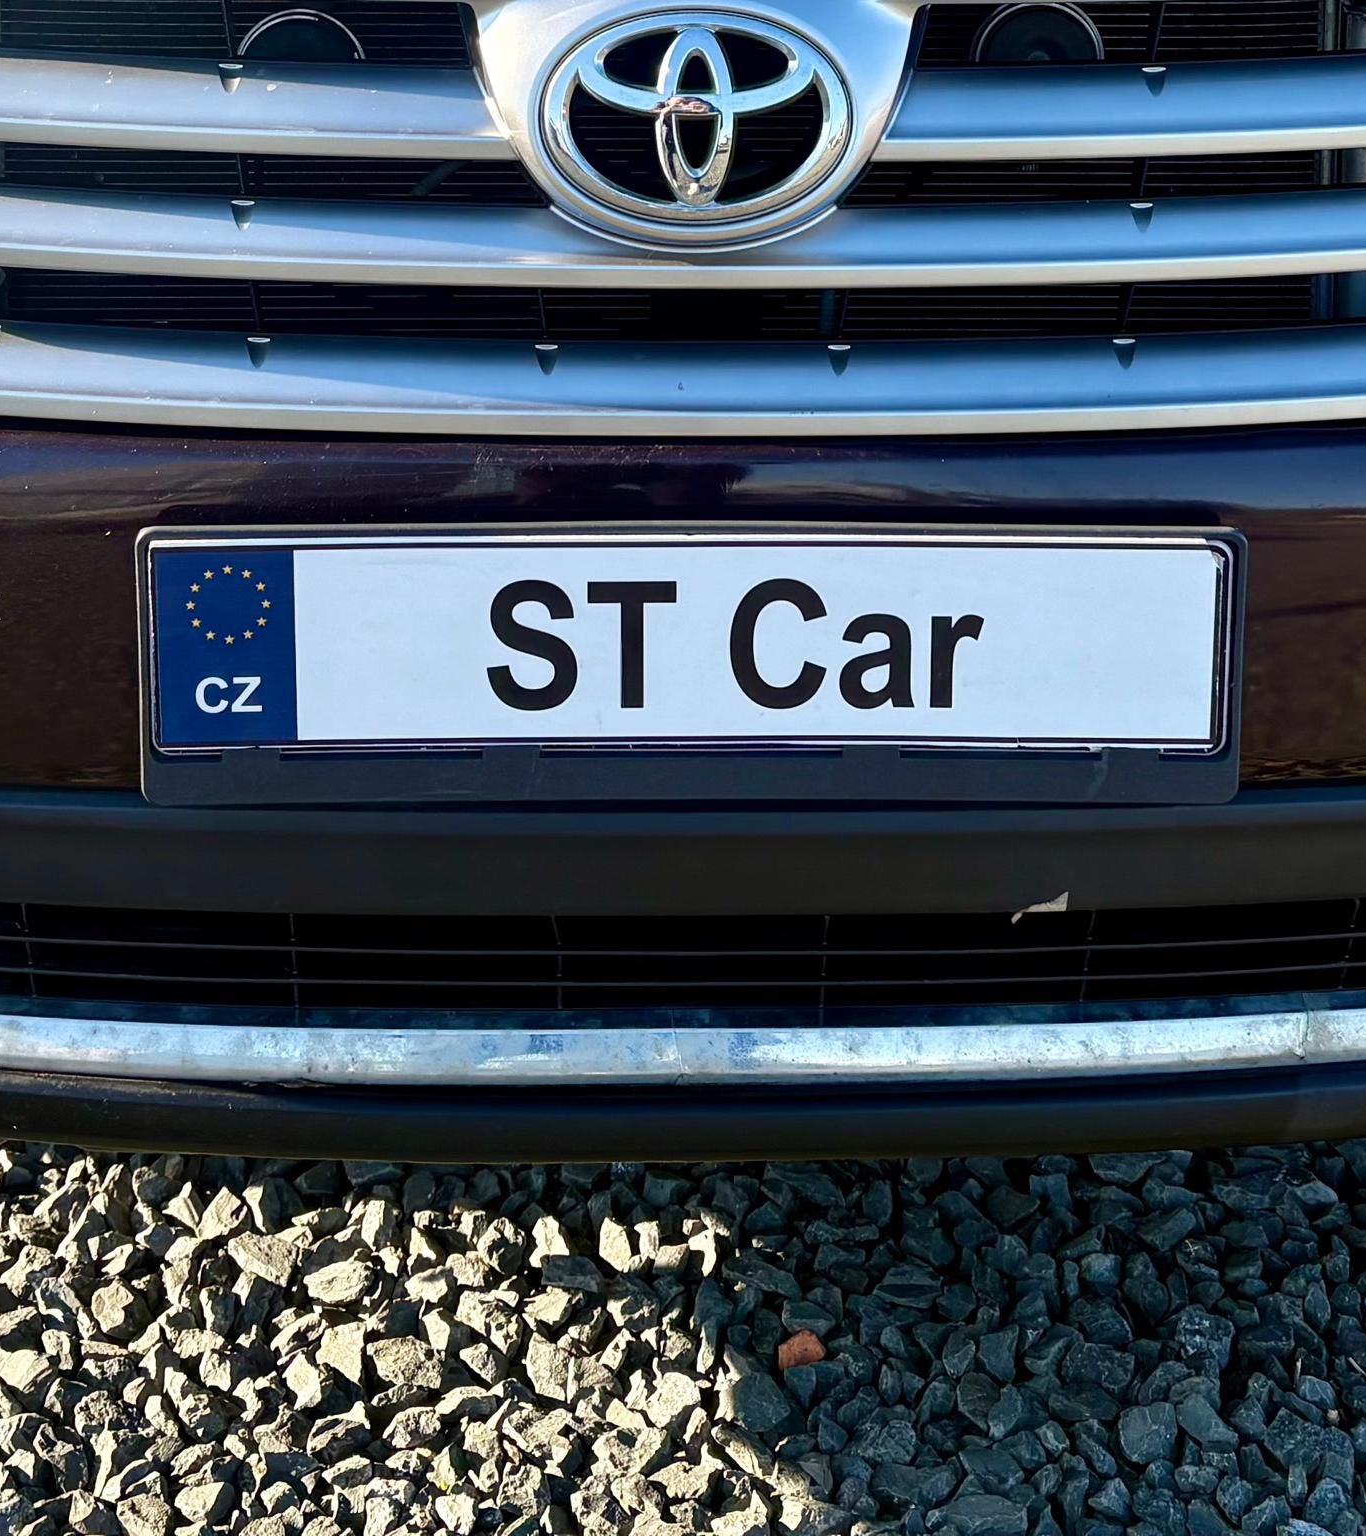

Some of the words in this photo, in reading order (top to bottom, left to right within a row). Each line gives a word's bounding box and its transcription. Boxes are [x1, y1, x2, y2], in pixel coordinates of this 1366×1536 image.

[485, 578, 678, 713] ST
[729, 578, 985, 712] Car
[194, 675, 264, 715] CZ
